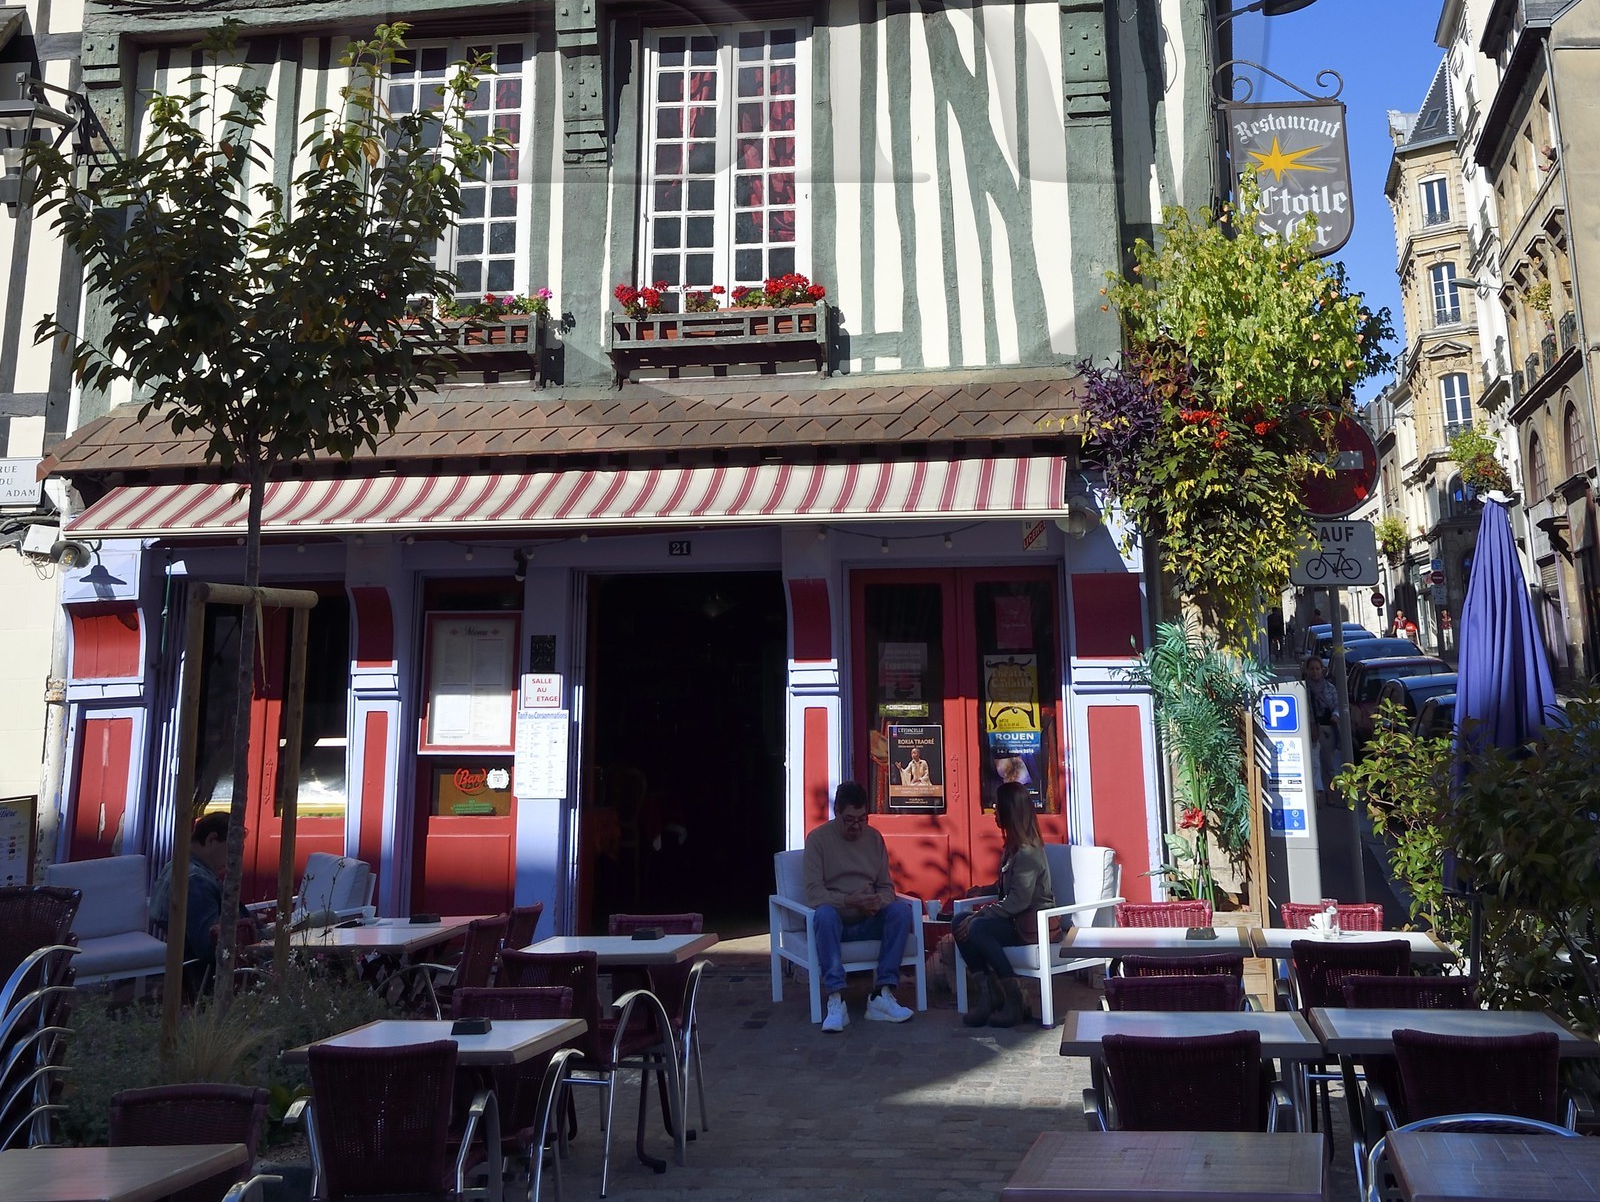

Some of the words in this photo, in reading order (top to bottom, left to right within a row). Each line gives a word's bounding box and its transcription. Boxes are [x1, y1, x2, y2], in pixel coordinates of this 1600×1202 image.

[1234, 113, 1341, 144] Restaurant
[1239, 184, 1347, 216] Etoile
[6, 489, 36, 497] ADAM
[1311, 526, 1355, 542] AUF
[671, 542, 689, 554] 21
[464, 626, 489, 636] Menu
[1269, 699, 1290, 727] P
[995, 733, 1034, 741] ROUEN
[458, 769, 482, 785] Bar
